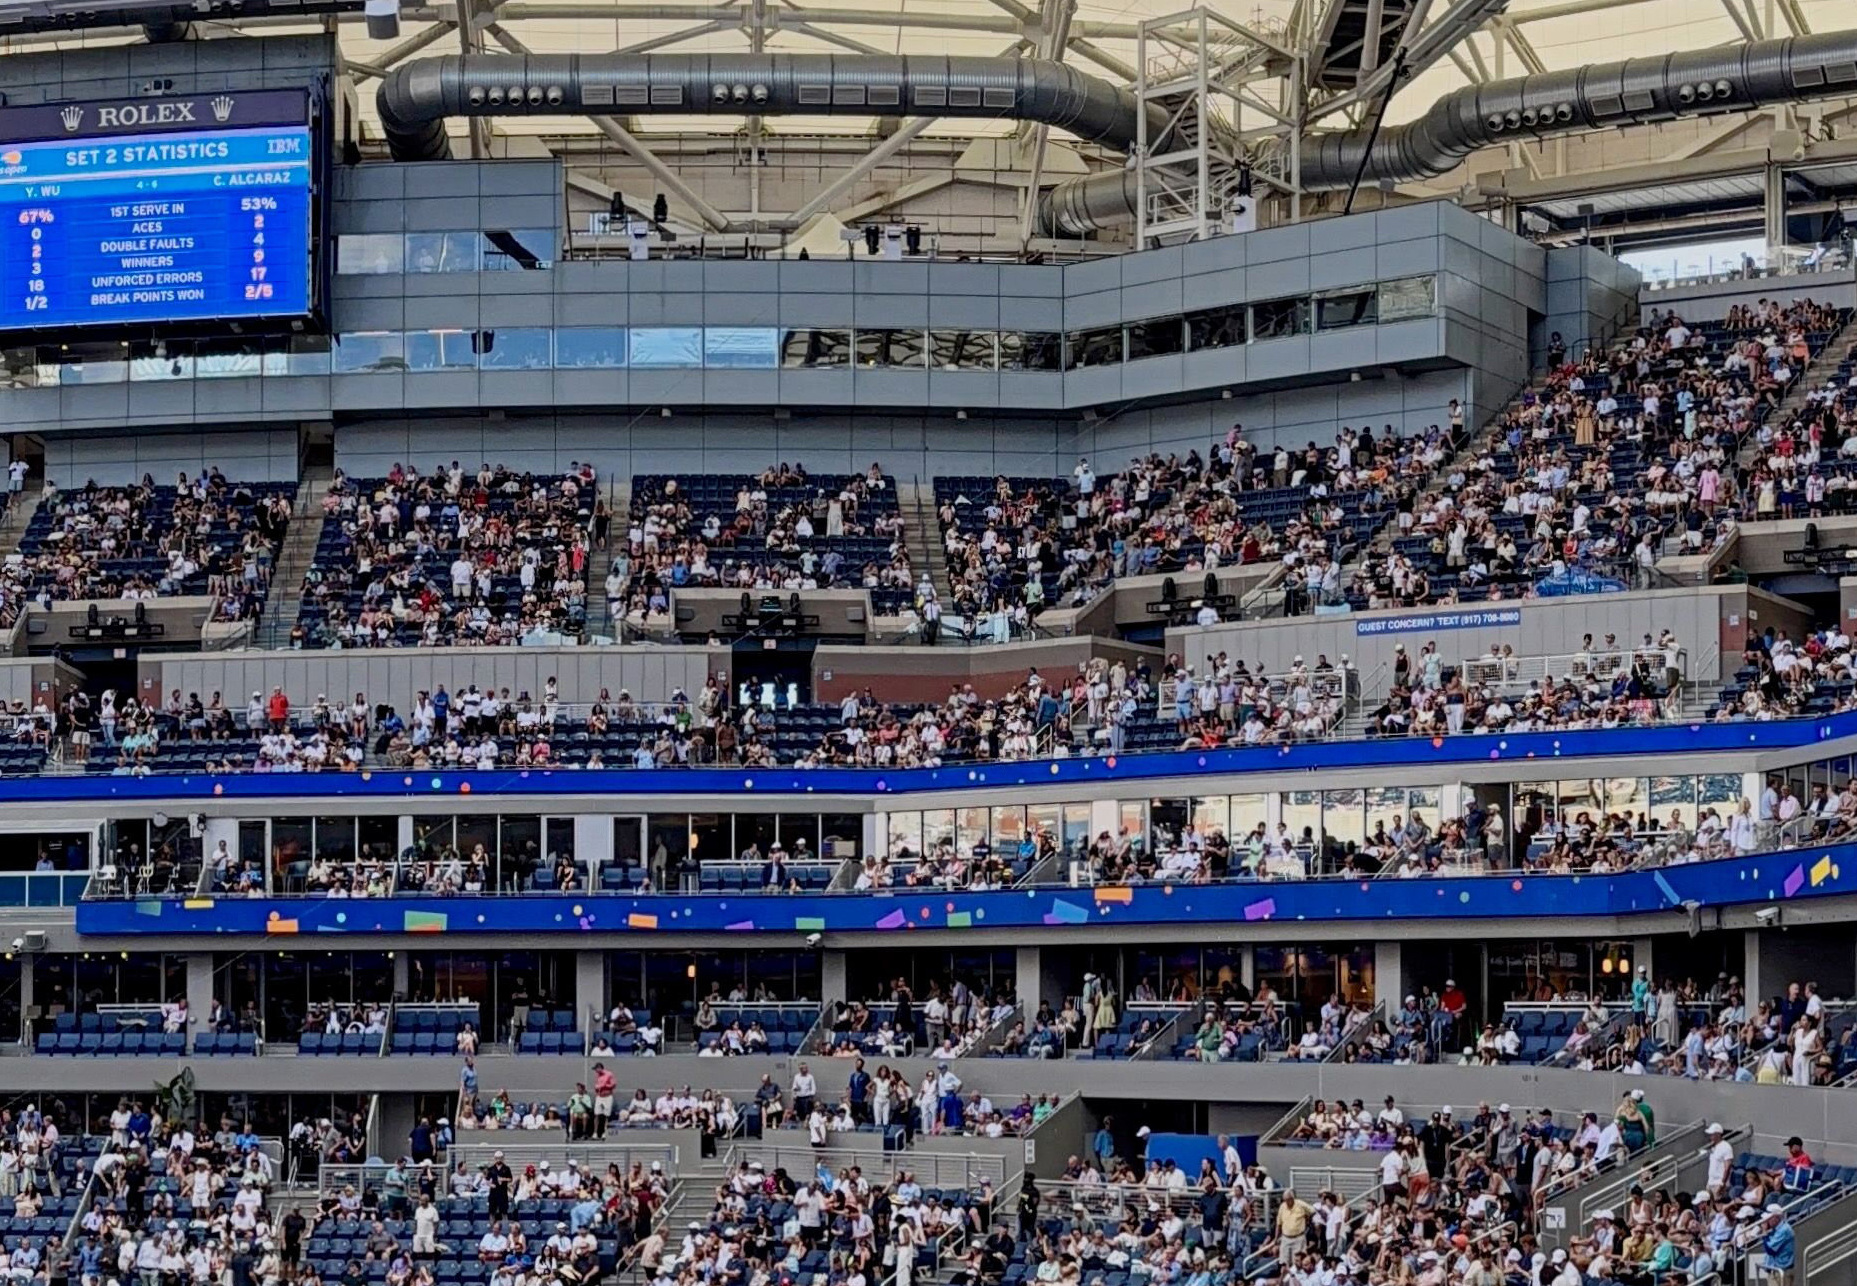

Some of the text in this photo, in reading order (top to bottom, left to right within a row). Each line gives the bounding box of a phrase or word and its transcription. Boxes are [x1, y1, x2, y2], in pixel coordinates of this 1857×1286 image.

[99, 103, 195, 126] ROLEX
[67, 142, 228, 166] SET 2 STATISTICS
[268, 138, 300, 153] IBM
[26, 172, 290, 197] Y. WU C. ALCARAZ
[19, 197, 276, 223] 67% 1ST SERVE IN 53%
[133, 215, 263, 233] ACES 2
[33, 233, 264, 258] 2 DOUBLE FAULTS 4
[32, 254, 173, 274] 3 WINNERS
[29, 267, 266, 291] 18 UNFORCED ERRORS 17
[26, 284, 272, 310] 1/2 BREAK POINTS WON 2/5
[1358, 621, 1386, 631] GUEST
[1388, 618, 1434, 629] CONCERN?
[1437, 616, 1459, 625] TEXT
